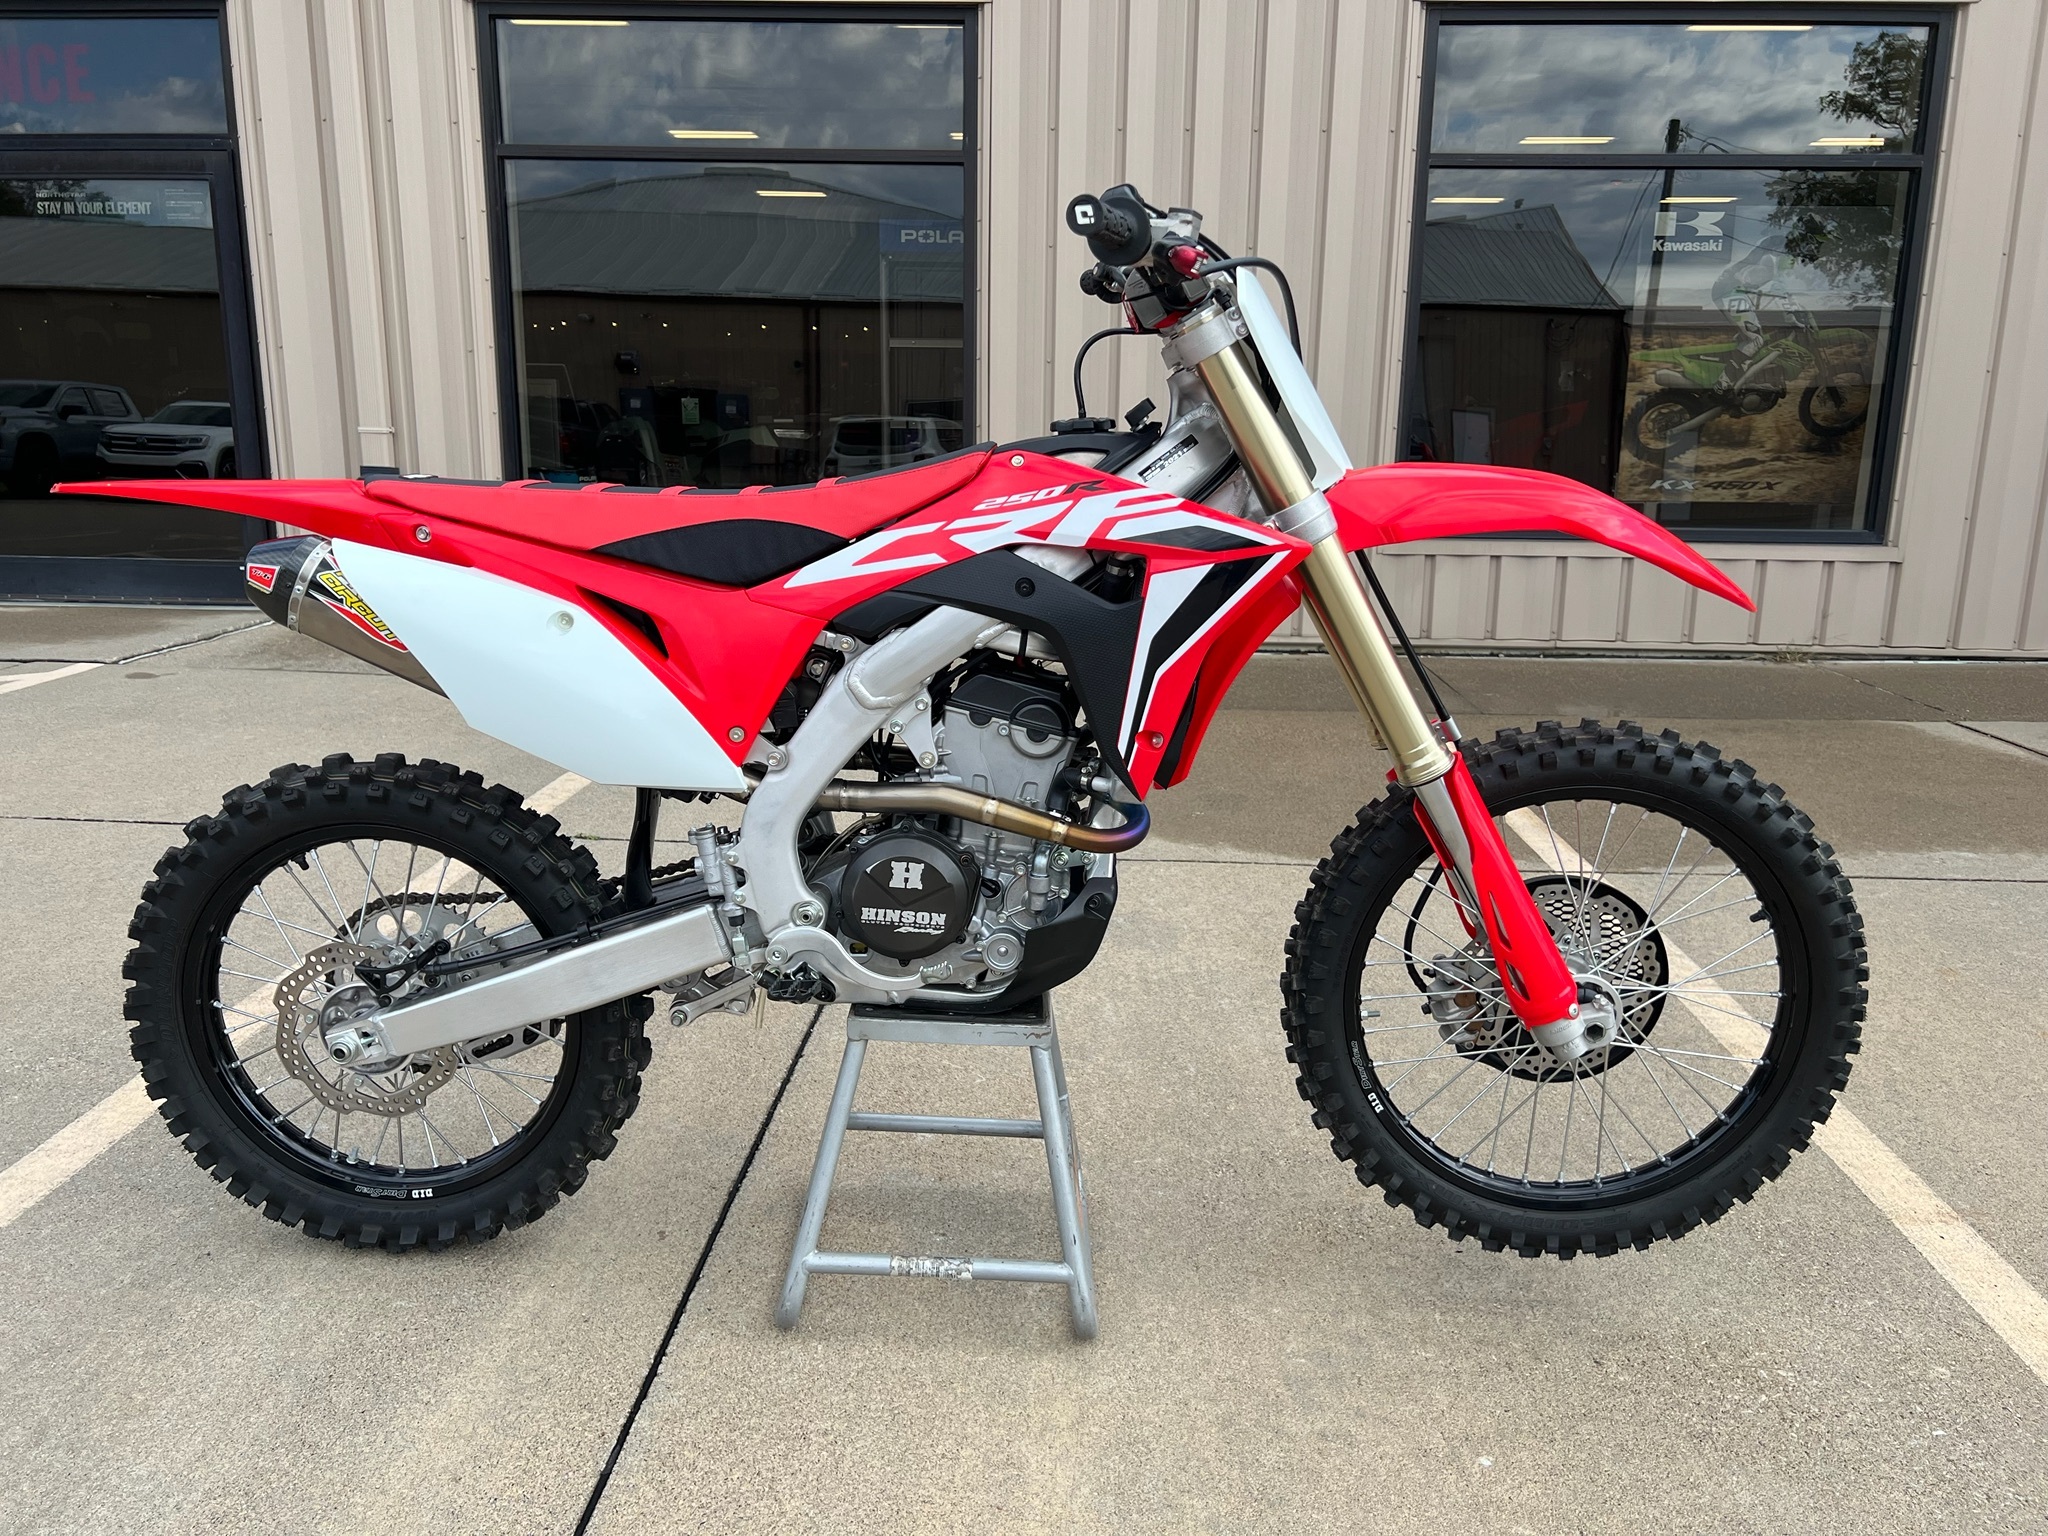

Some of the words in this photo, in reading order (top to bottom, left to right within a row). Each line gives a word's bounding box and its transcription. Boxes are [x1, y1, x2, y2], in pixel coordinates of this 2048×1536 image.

[37, 201, 61, 214] STAY
[64, 202, 75, 214] IN
[77, 202, 105, 215] YOUR
[106, 202, 152, 215] ELEMENT
[1652, 240, 1723, 251] Kawasaki
[1649, 480, 1700, 490] KX
[784, 488, 1184, 588] CRF
[318, 571, 397, 640] CIRCUIT
[889, 861, 924, 889] H
[861, 907, 946, 925] HINSON
[1367, 1092, 1384, 1113] DID
[412, 1188, 433, 1199] DID
